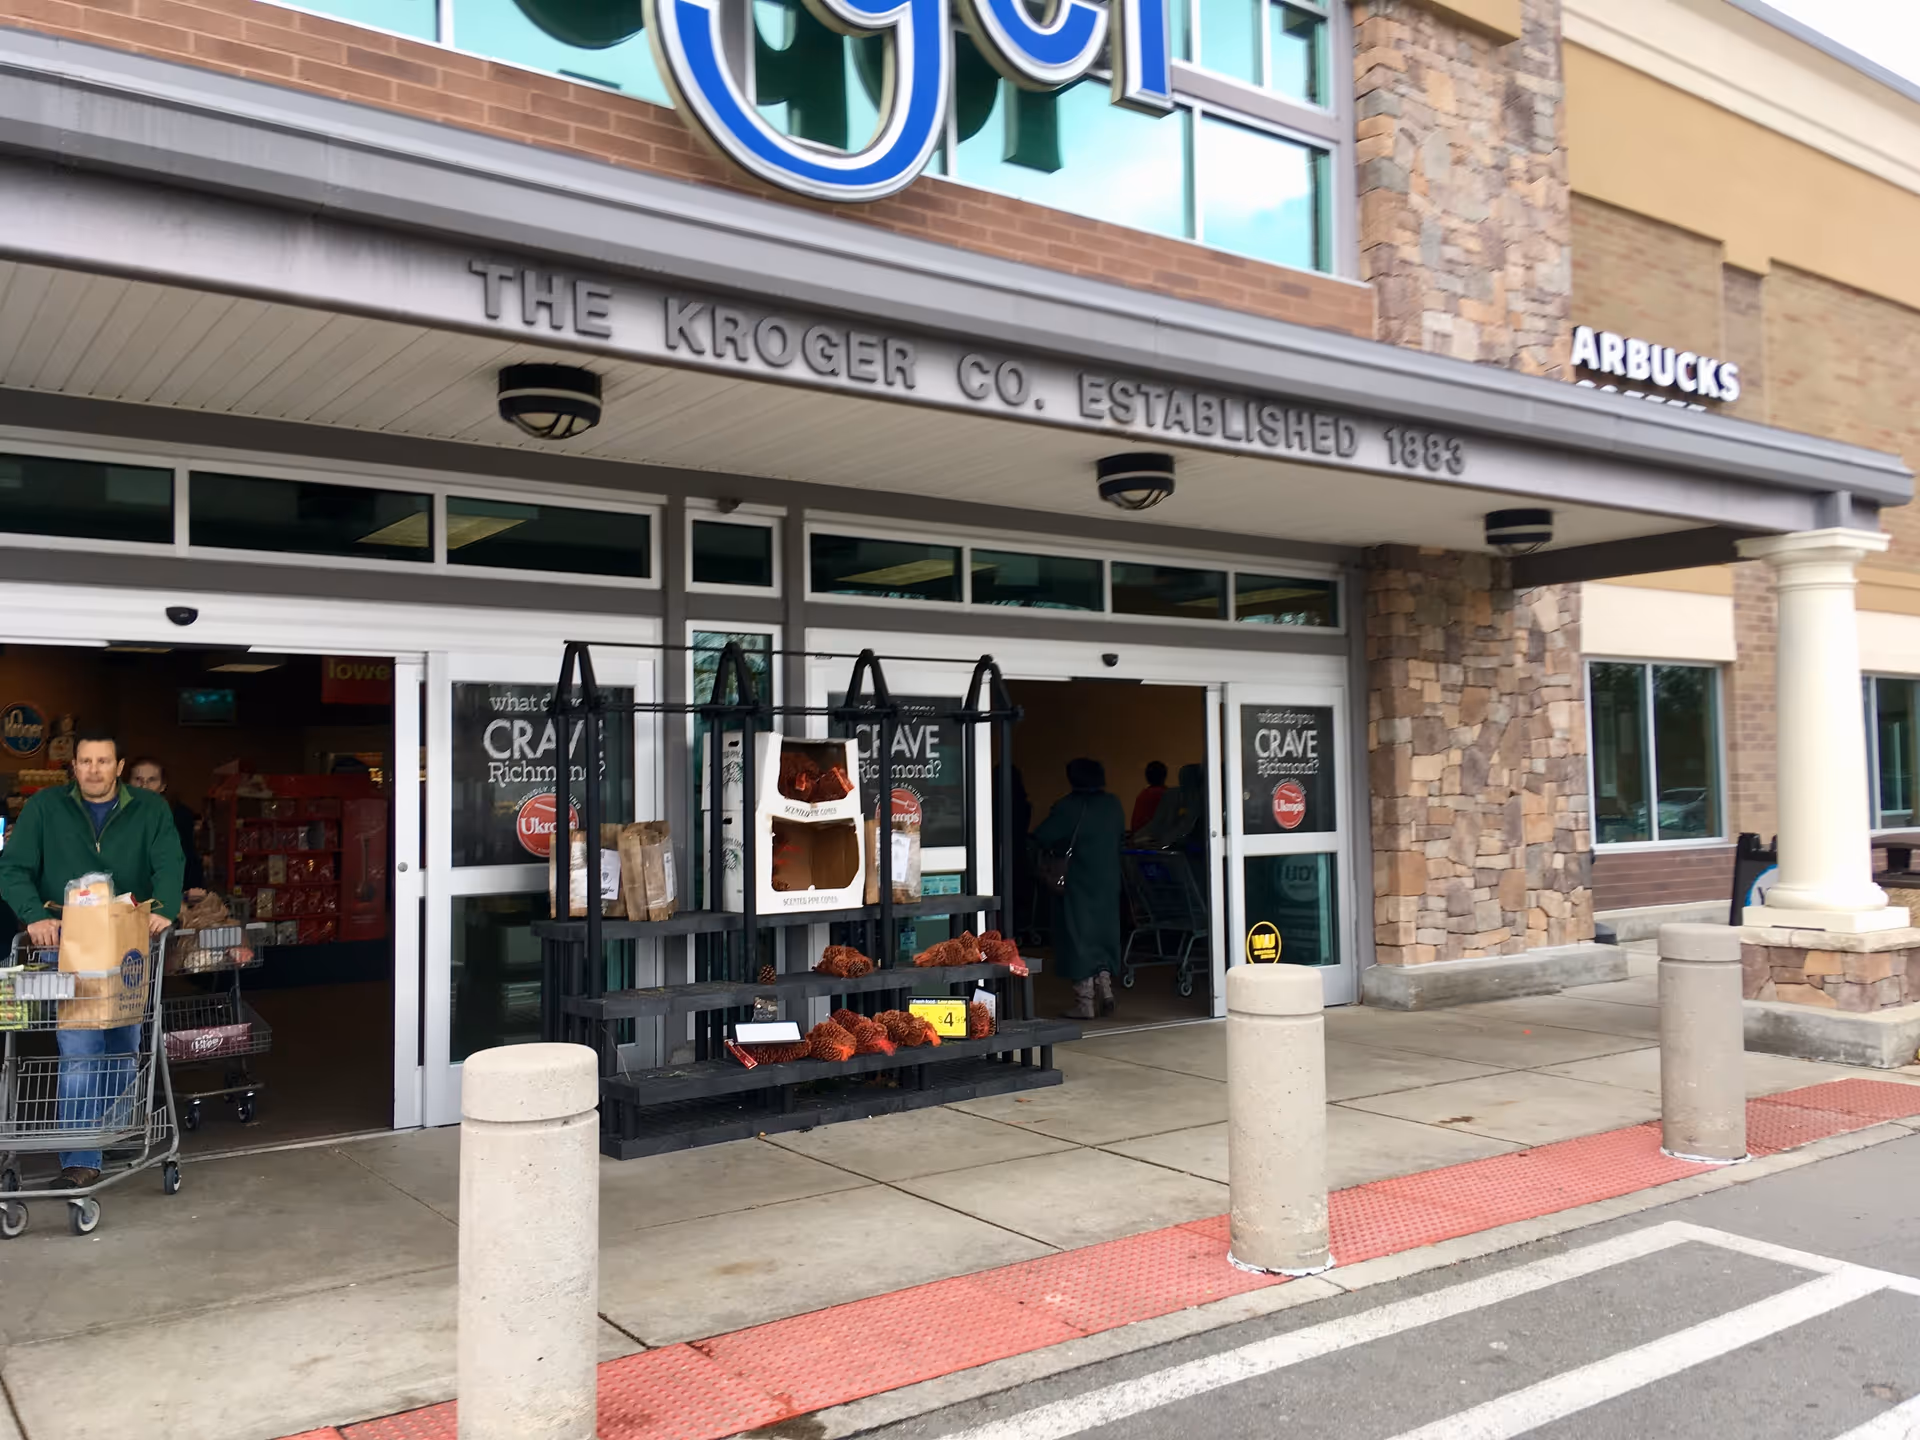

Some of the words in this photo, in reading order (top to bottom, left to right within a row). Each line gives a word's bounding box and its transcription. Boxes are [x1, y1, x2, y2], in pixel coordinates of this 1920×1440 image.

[469, 260, 612, 339] THE
[664, 297, 917, 389] KROGER
[957, 352, 1044, 411] CO.
[1079, 372, 1359, 459] ESTABLISHED
[1384, 425, 1466, 475] 1883
[489, 691, 539, 712] what
[1254, 728, 1318, 758] CRAVE
[859, 759, 942, 783] Ricmond?
